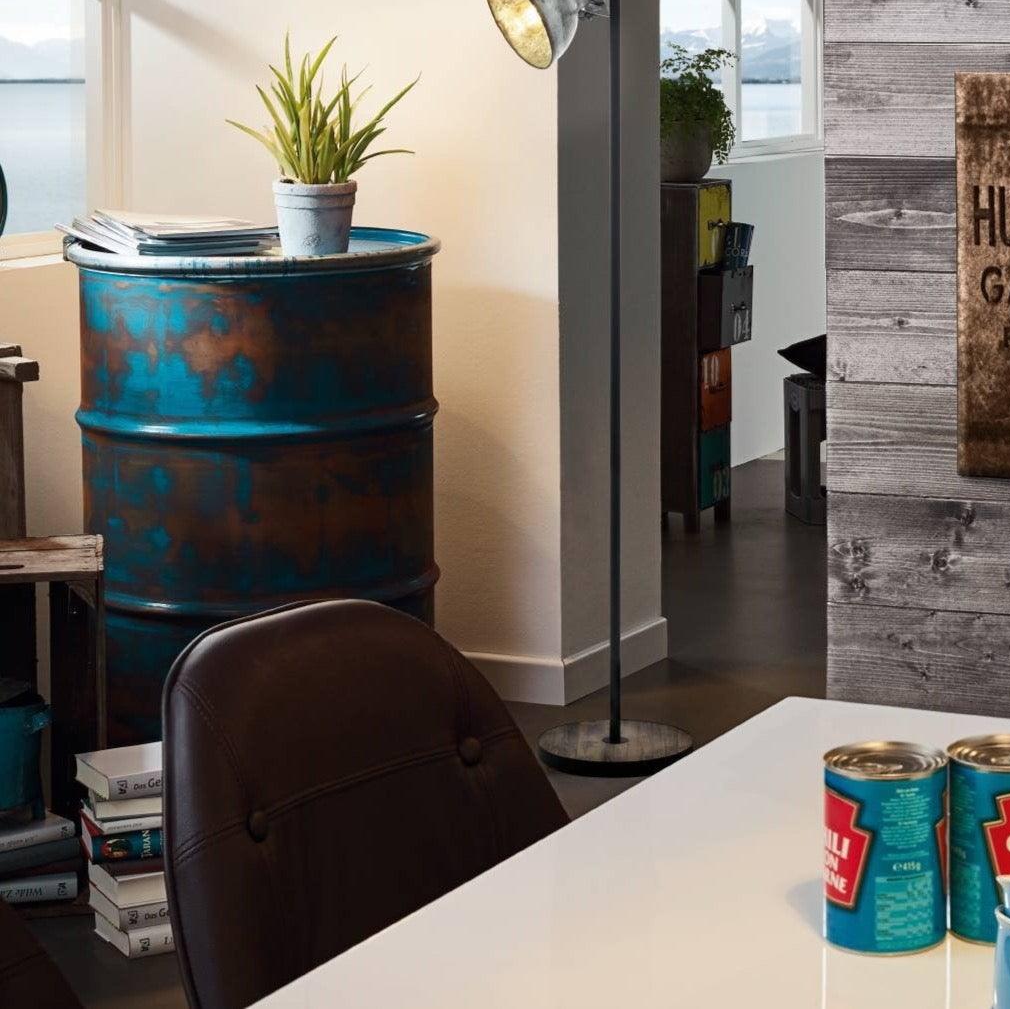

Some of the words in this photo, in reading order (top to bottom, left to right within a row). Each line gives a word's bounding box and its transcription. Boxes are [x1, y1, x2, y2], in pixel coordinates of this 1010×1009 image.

[133, 783, 146, 791] Das
[147, 777, 163, 788] Ge
[825, 851, 839, 872] ON
